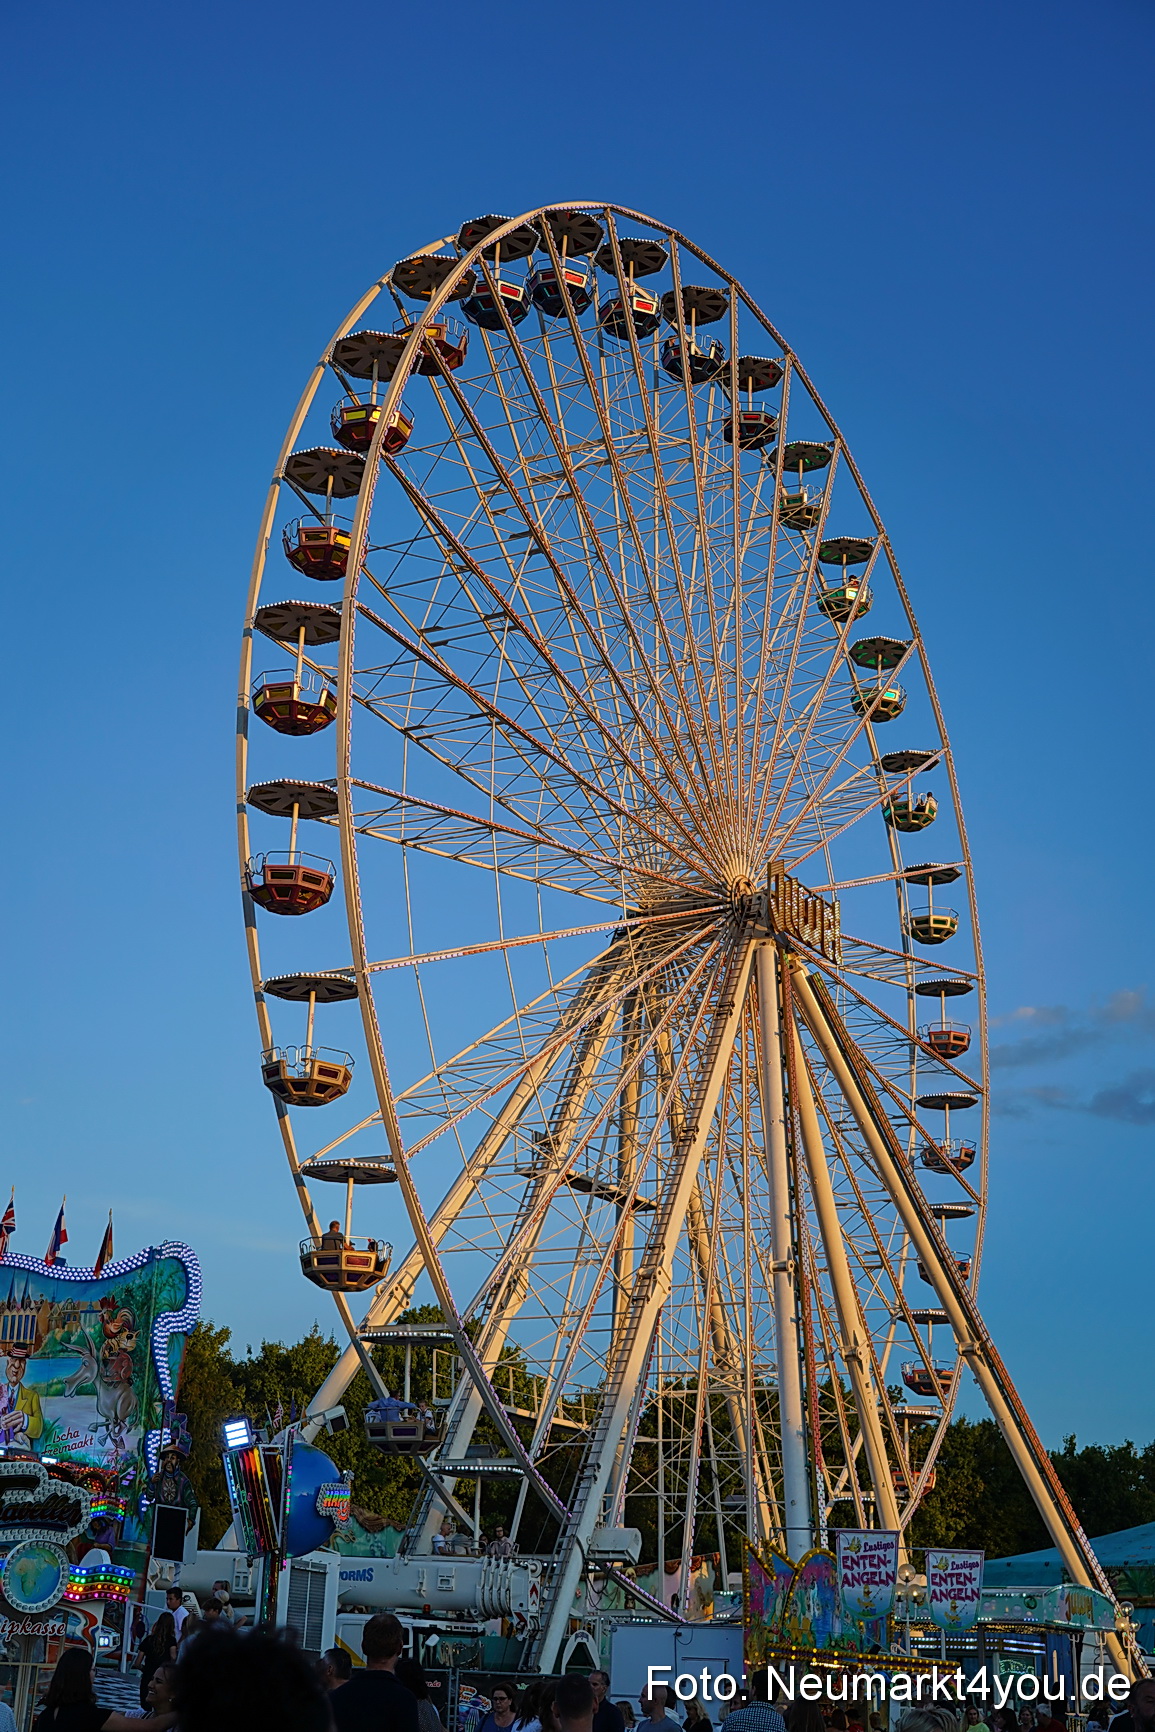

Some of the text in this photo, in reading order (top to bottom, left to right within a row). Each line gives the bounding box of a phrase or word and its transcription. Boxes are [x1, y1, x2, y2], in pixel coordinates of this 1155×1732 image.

[53, 1427, 80, 1443] Ischa
[863, 1541, 895, 1553] Lustiges
[842, 1554, 892, 1571] ENTEN-
[951, 1560, 980, 1571] Lustiges
[339, 1567, 374, 1582] ORMS
[841, 1571, 896, 1588] ANGELN
[931, 1572, 977, 1587] ENTEN-
[930, 1588, 980, 1603] ANGELN
